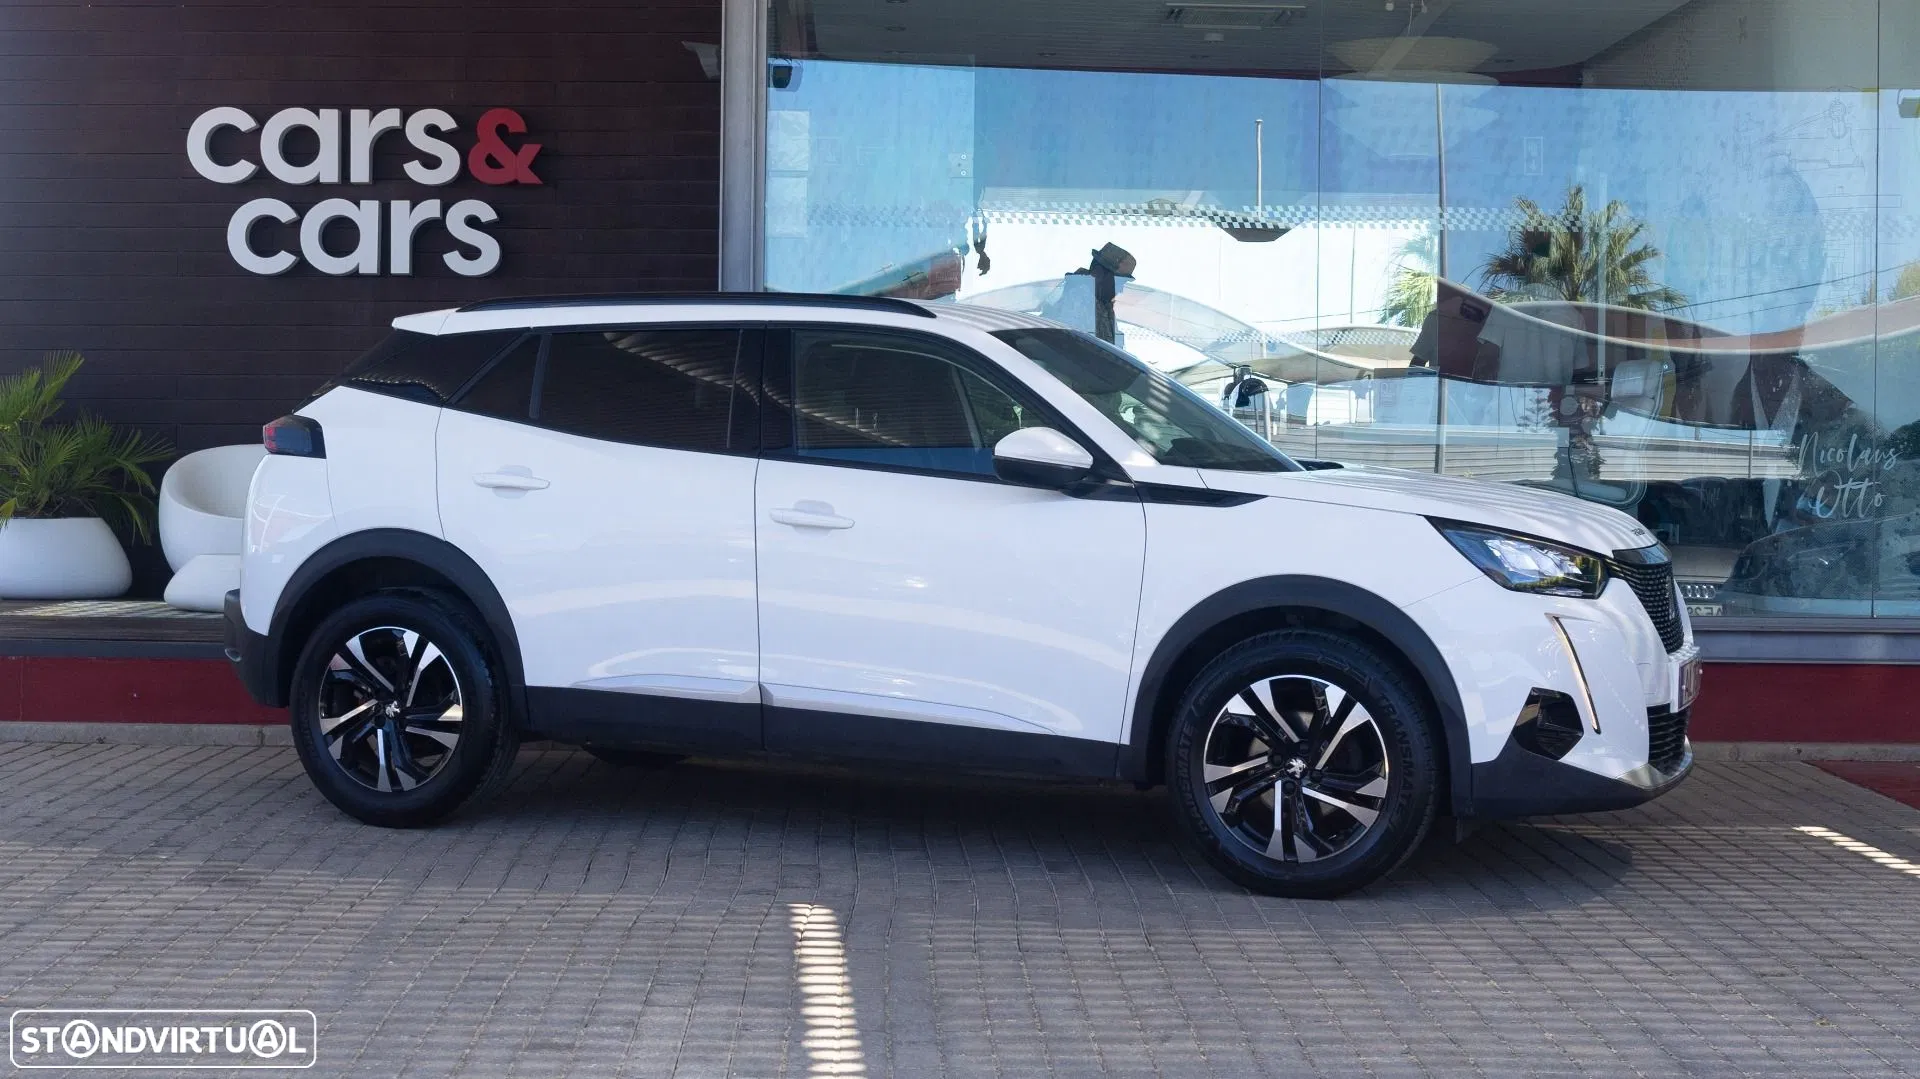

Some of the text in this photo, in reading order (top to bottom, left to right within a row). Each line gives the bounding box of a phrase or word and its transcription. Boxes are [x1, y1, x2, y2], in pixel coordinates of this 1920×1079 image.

[227, 197, 502, 277] cars
[1798, 431, 1904, 477] Nicolaus
[1807, 470, 1887, 519] Otto
